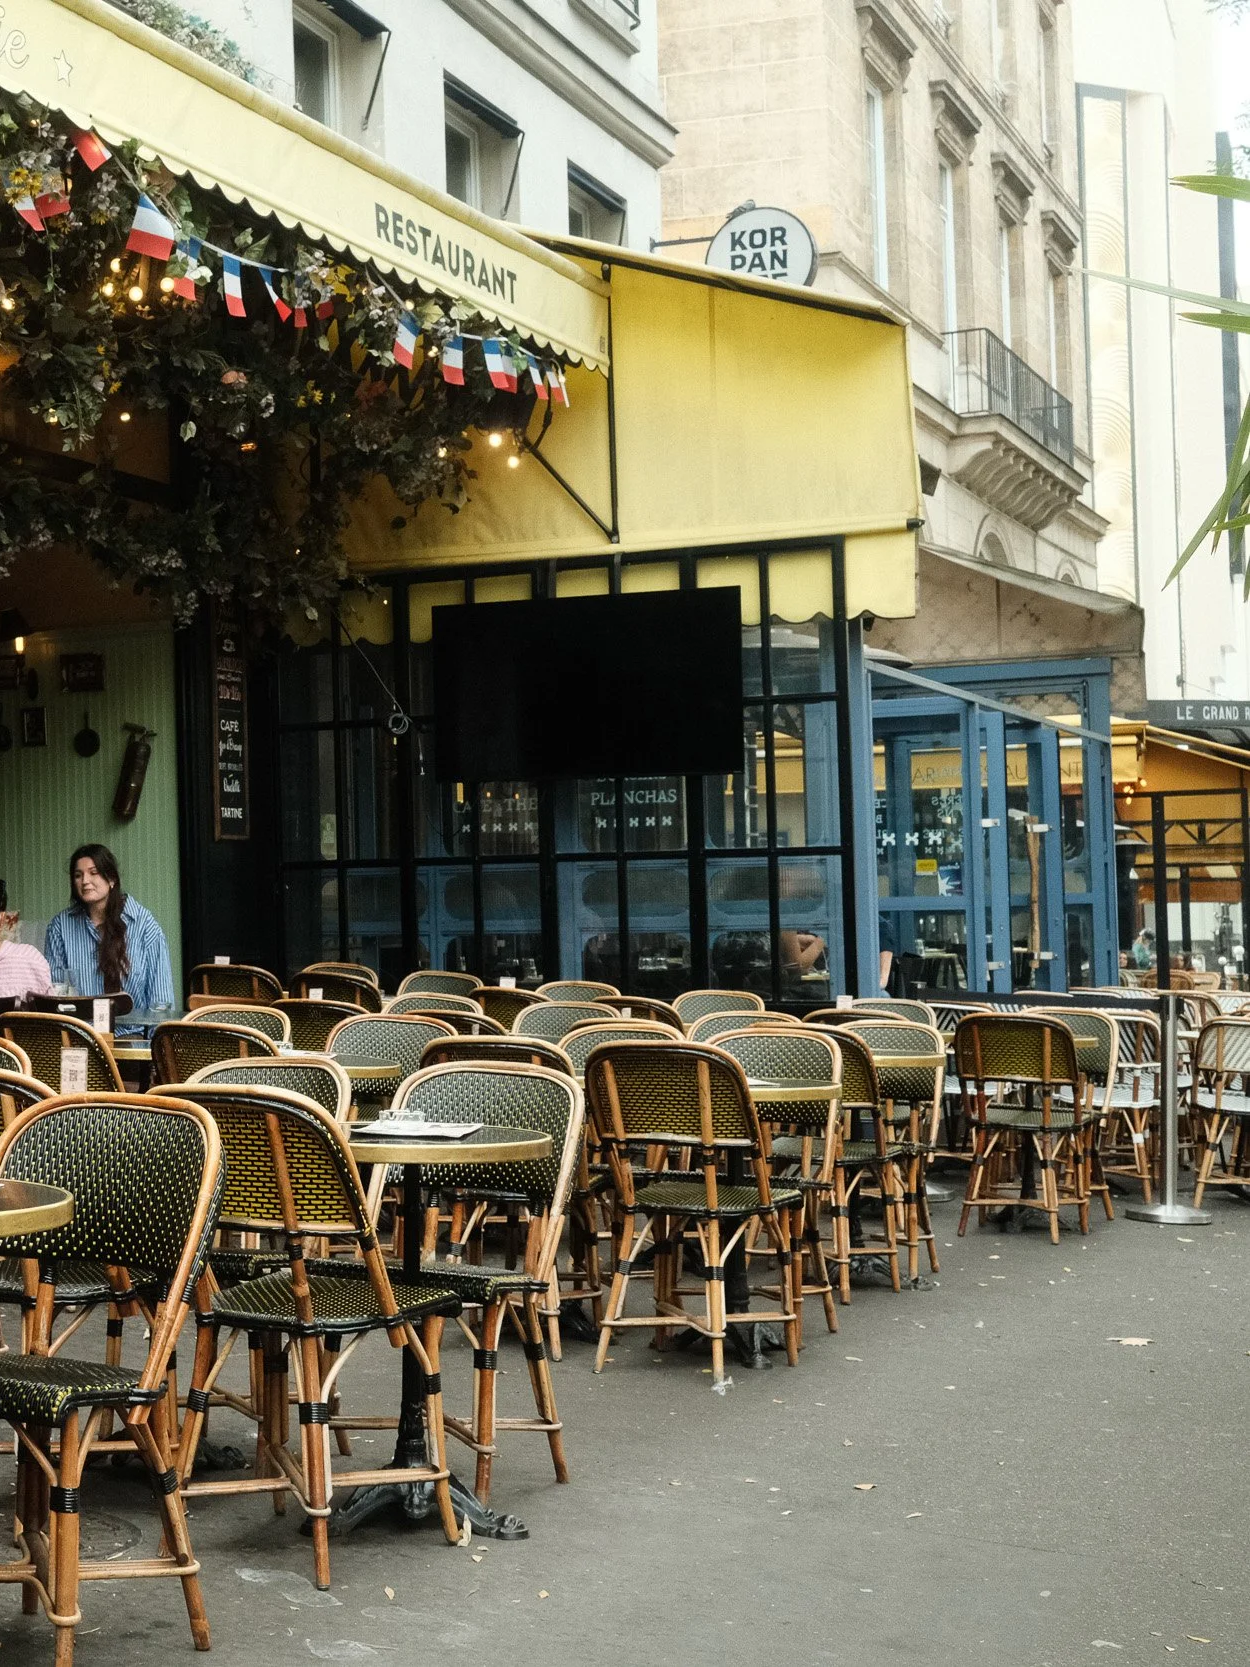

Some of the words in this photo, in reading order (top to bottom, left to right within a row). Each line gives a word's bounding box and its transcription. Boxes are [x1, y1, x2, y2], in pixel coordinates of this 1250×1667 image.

[730, 226, 788, 252] KOR
[375, 202, 517, 304] RESTAURANT
[730, 249, 788, 273] PAN
[1176, 706, 1194, 720] LE
[1202, 705, 1240, 720] GRAND
